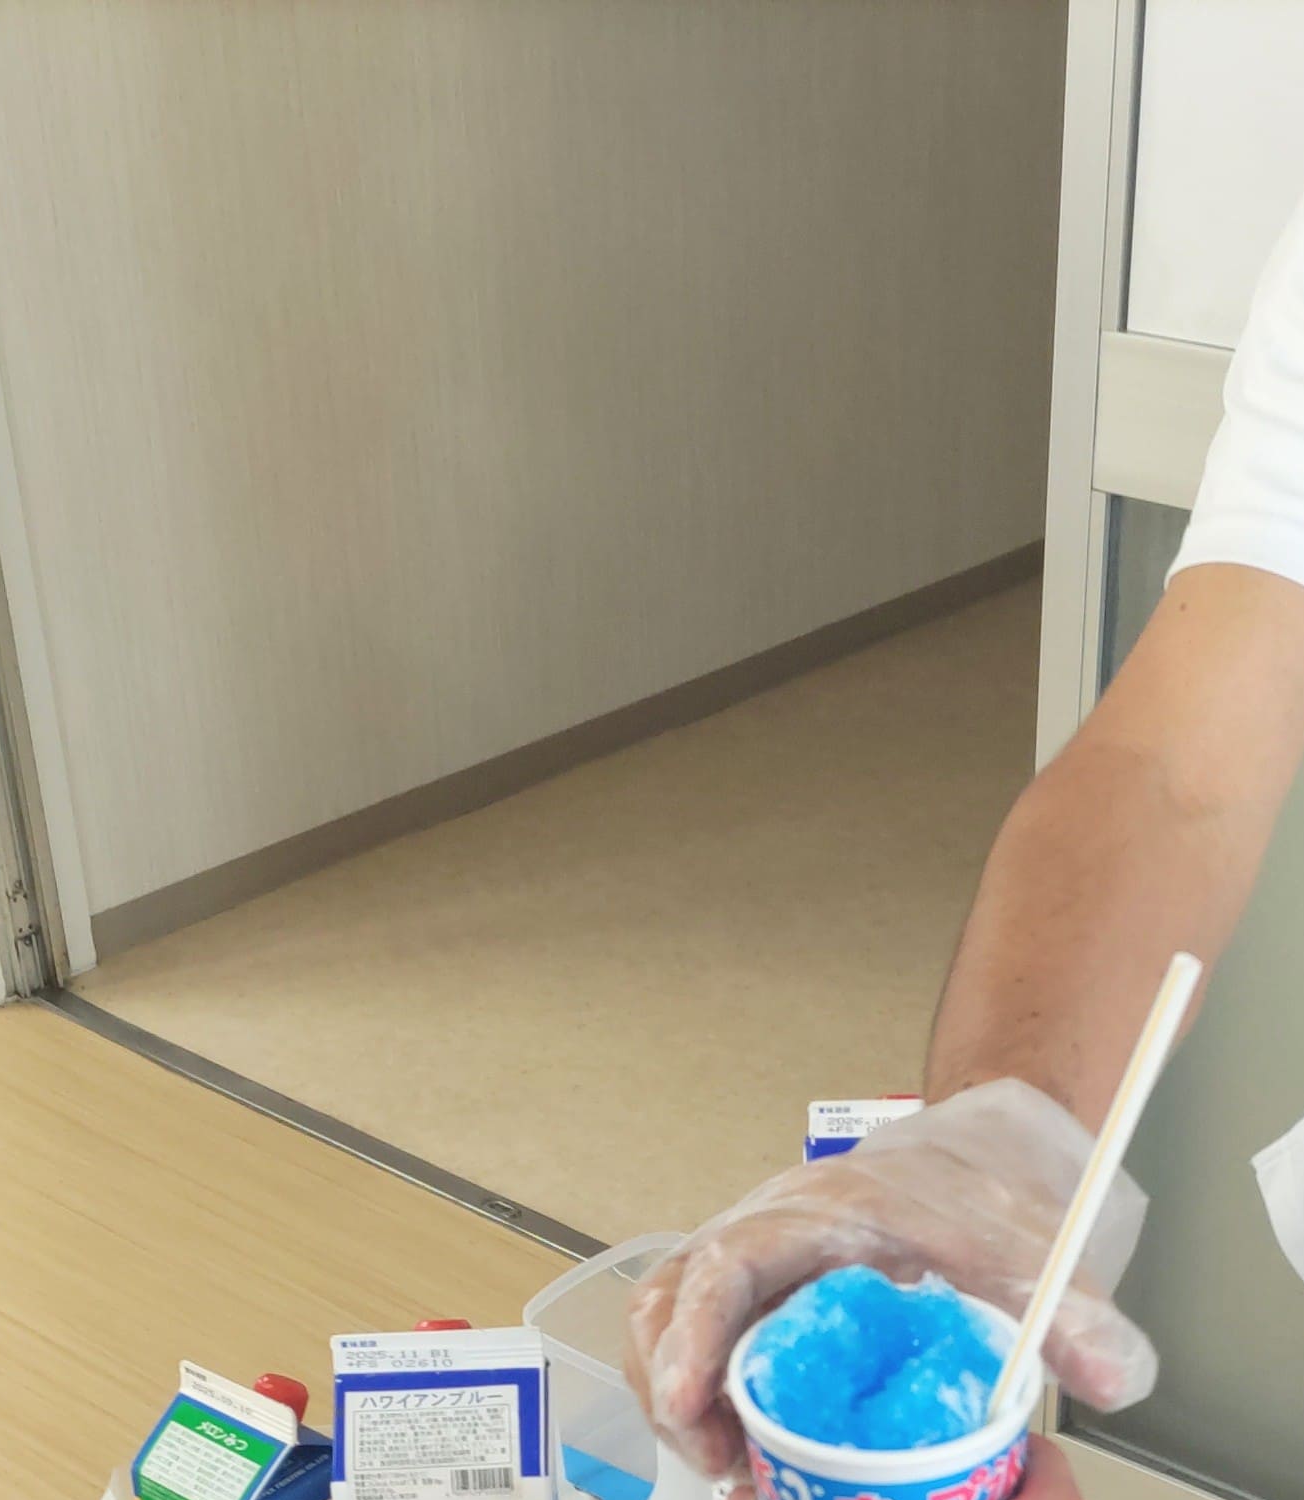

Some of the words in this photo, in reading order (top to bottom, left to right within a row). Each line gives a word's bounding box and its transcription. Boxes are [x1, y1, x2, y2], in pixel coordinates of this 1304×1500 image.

[360, 1390, 503, 1409] ハワイアンブルー
